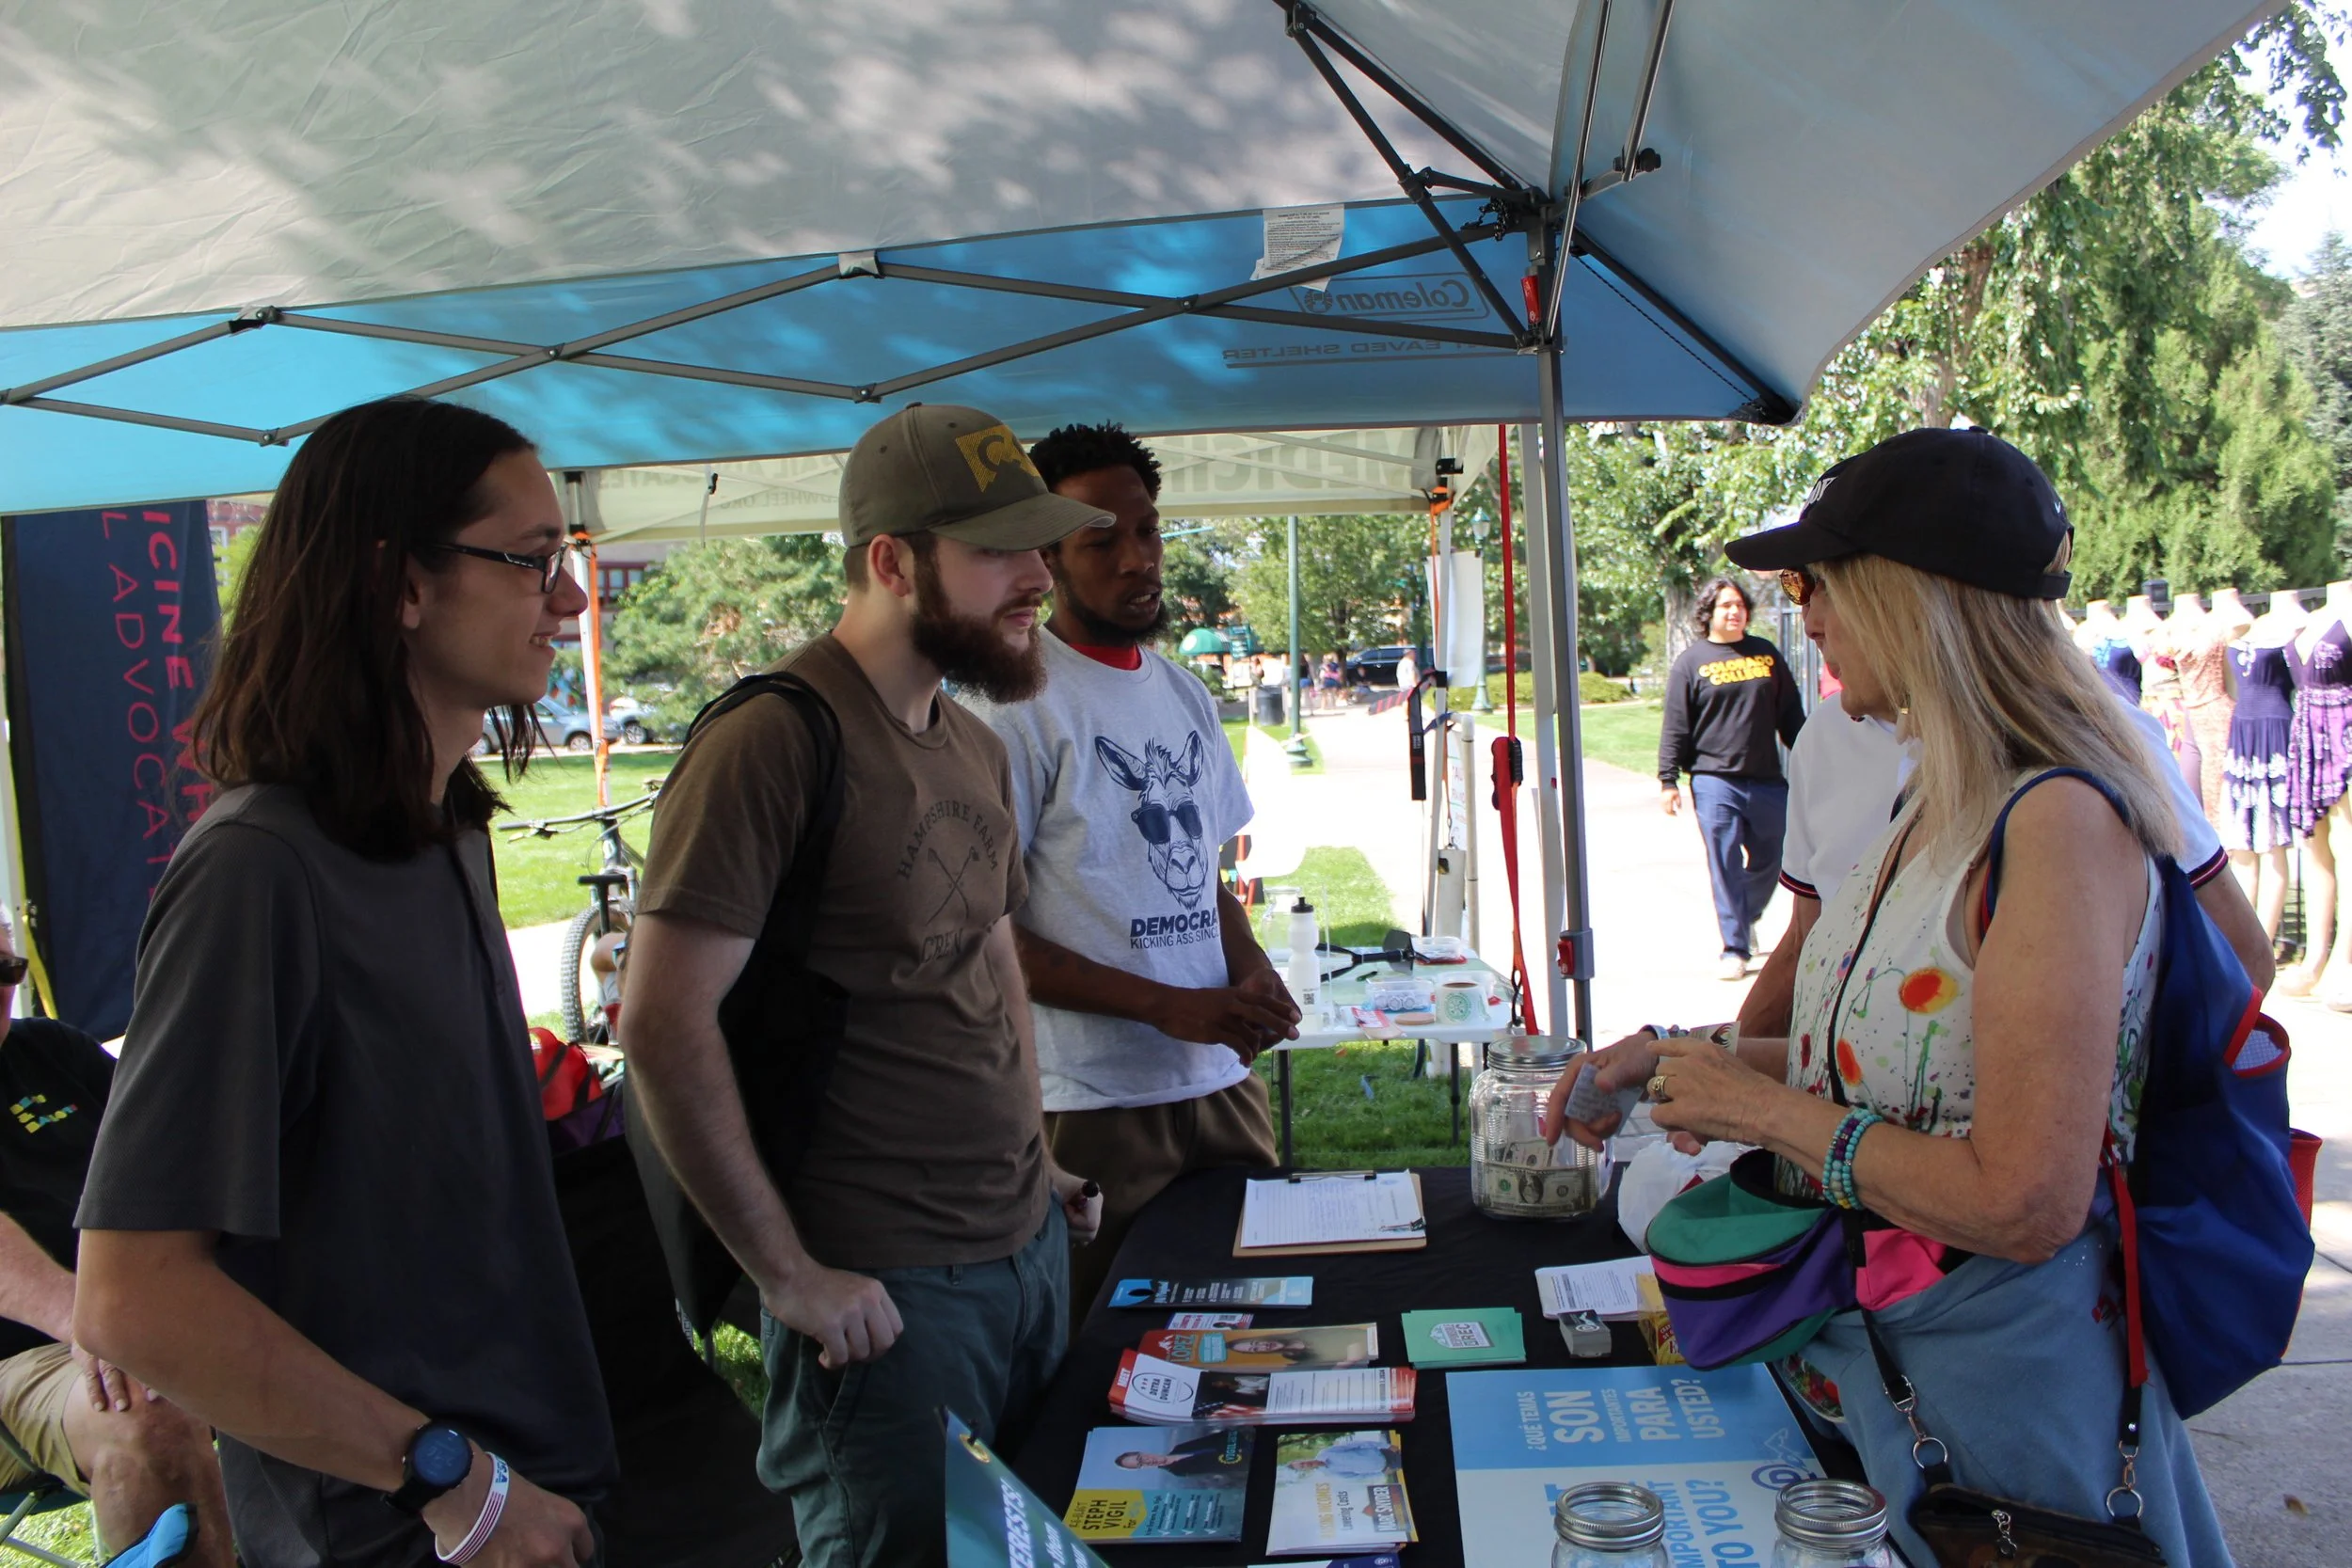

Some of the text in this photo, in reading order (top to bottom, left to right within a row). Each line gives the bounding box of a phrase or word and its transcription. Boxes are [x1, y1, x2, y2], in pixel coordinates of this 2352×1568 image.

[143, 511, 194, 689] ICINE
[1698, 655, 1774, 677] COLORADO
[1709, 666, 1772, 686] COLLEGE
[108, 563, 176, 865] ADVOCAT
[897, 800, 971, 879] HAMPSHIRE
[1130, 907, 1218, 938] DEMOCRA
[1131, 926, 1219, 950] KICKING ASS SINC
[1517, 1391, 1548, 1451] ¿QUÉ TEMAS
[1543, 1389, 1605, 1444] SON
[1600, 1387, 1632, 1443] IMPORTANTES
[1626, 1386, 1681, 1441] PARA
[1670, 1378, 1725, 1439] USTED?
[1082, 1499, 1108, 1531] STEPH
[1102, 1499, 1129, 1530] VIGIL
[1336, 1490, 1354, 1531] Lowering Costs
[1685, 1479, 1744, 1536] YOU?
